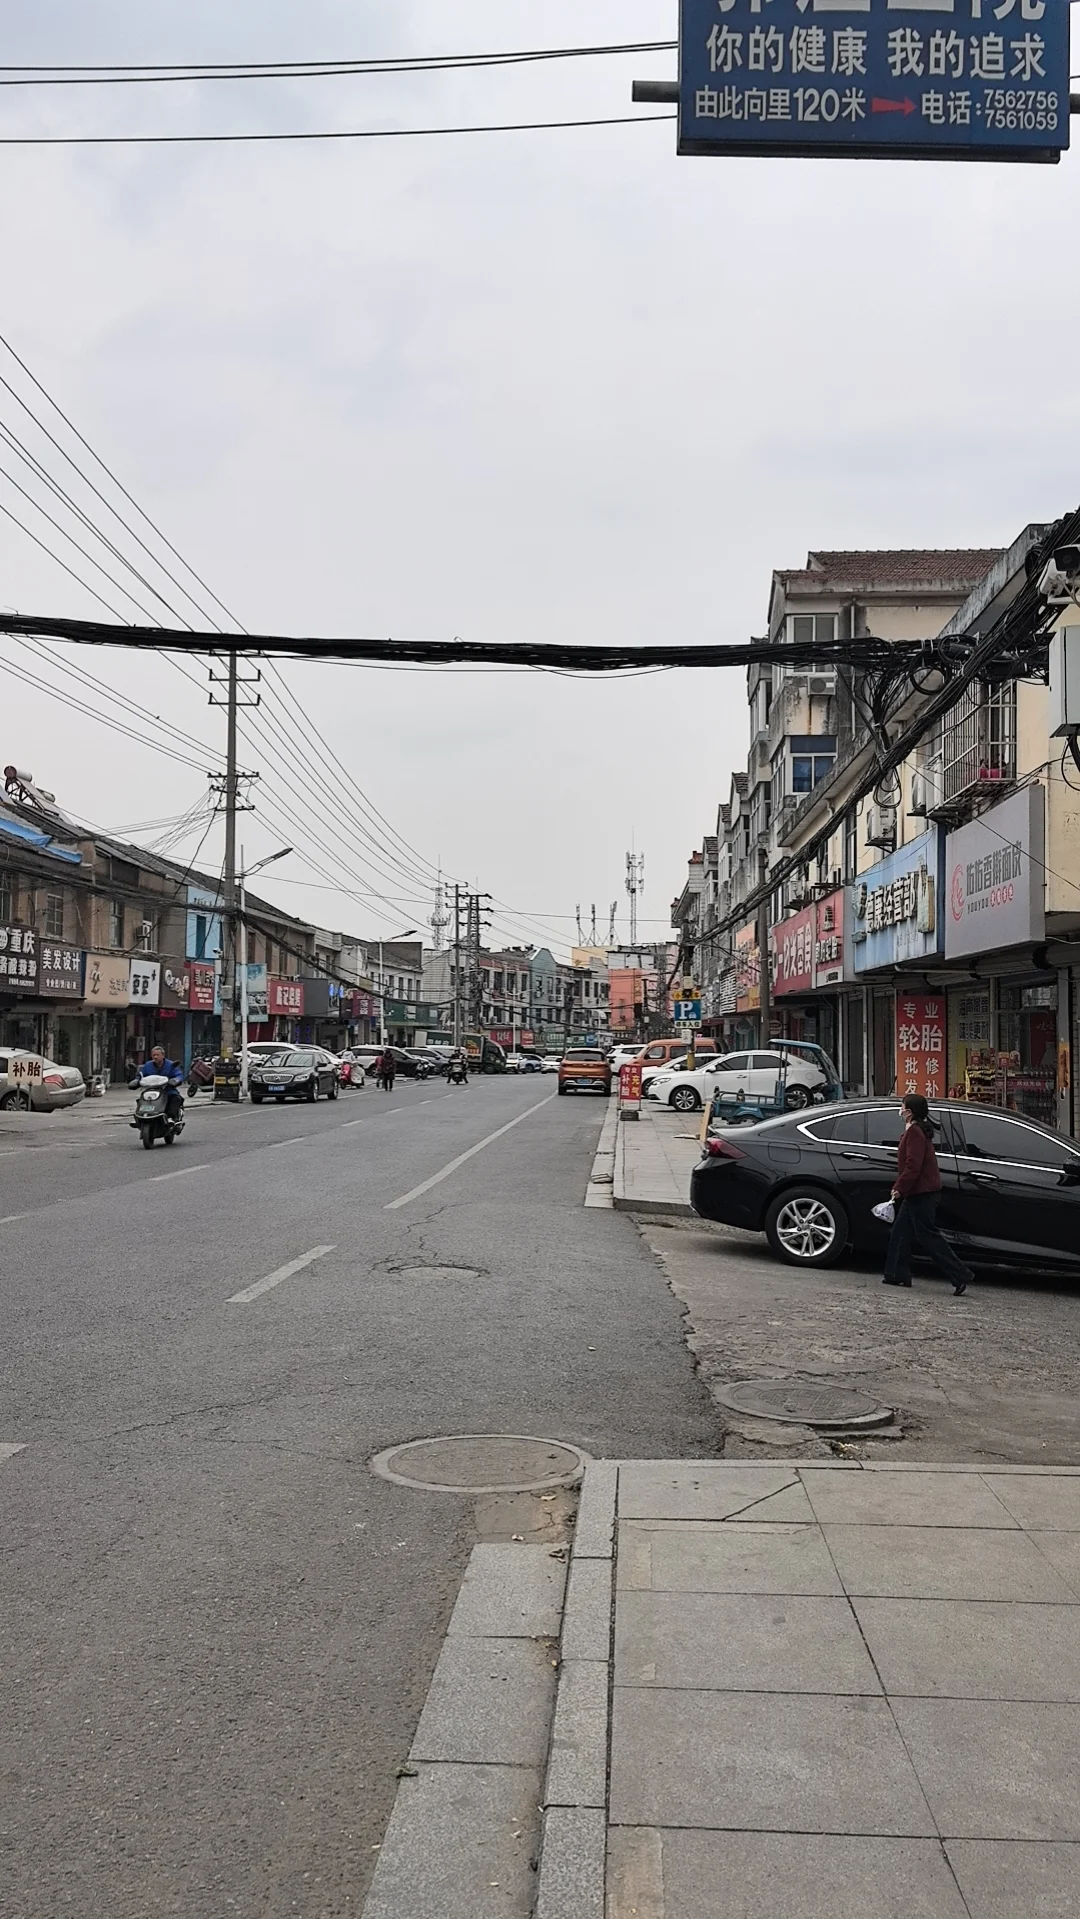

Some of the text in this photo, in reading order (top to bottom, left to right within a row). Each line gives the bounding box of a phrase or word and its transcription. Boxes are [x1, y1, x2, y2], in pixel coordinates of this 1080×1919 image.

[706, 24, 1046, 81] 你的健康 我的追求
[694, 86, 867, 122] 由此向里120米
[984, 89, 1058, 110] 7562756
[985, 110, 1058, 131] 7561059
[10, 928, 36, 954] 重庆
[42, 948, 81, 972] 美发设计
[679, 1001, 693, 1019] P
[903, 1002, 939, 1019] 专业
[899, 1023, 943, 1052] 轮胎
[13, 1061, 42, 1078] 补胎
